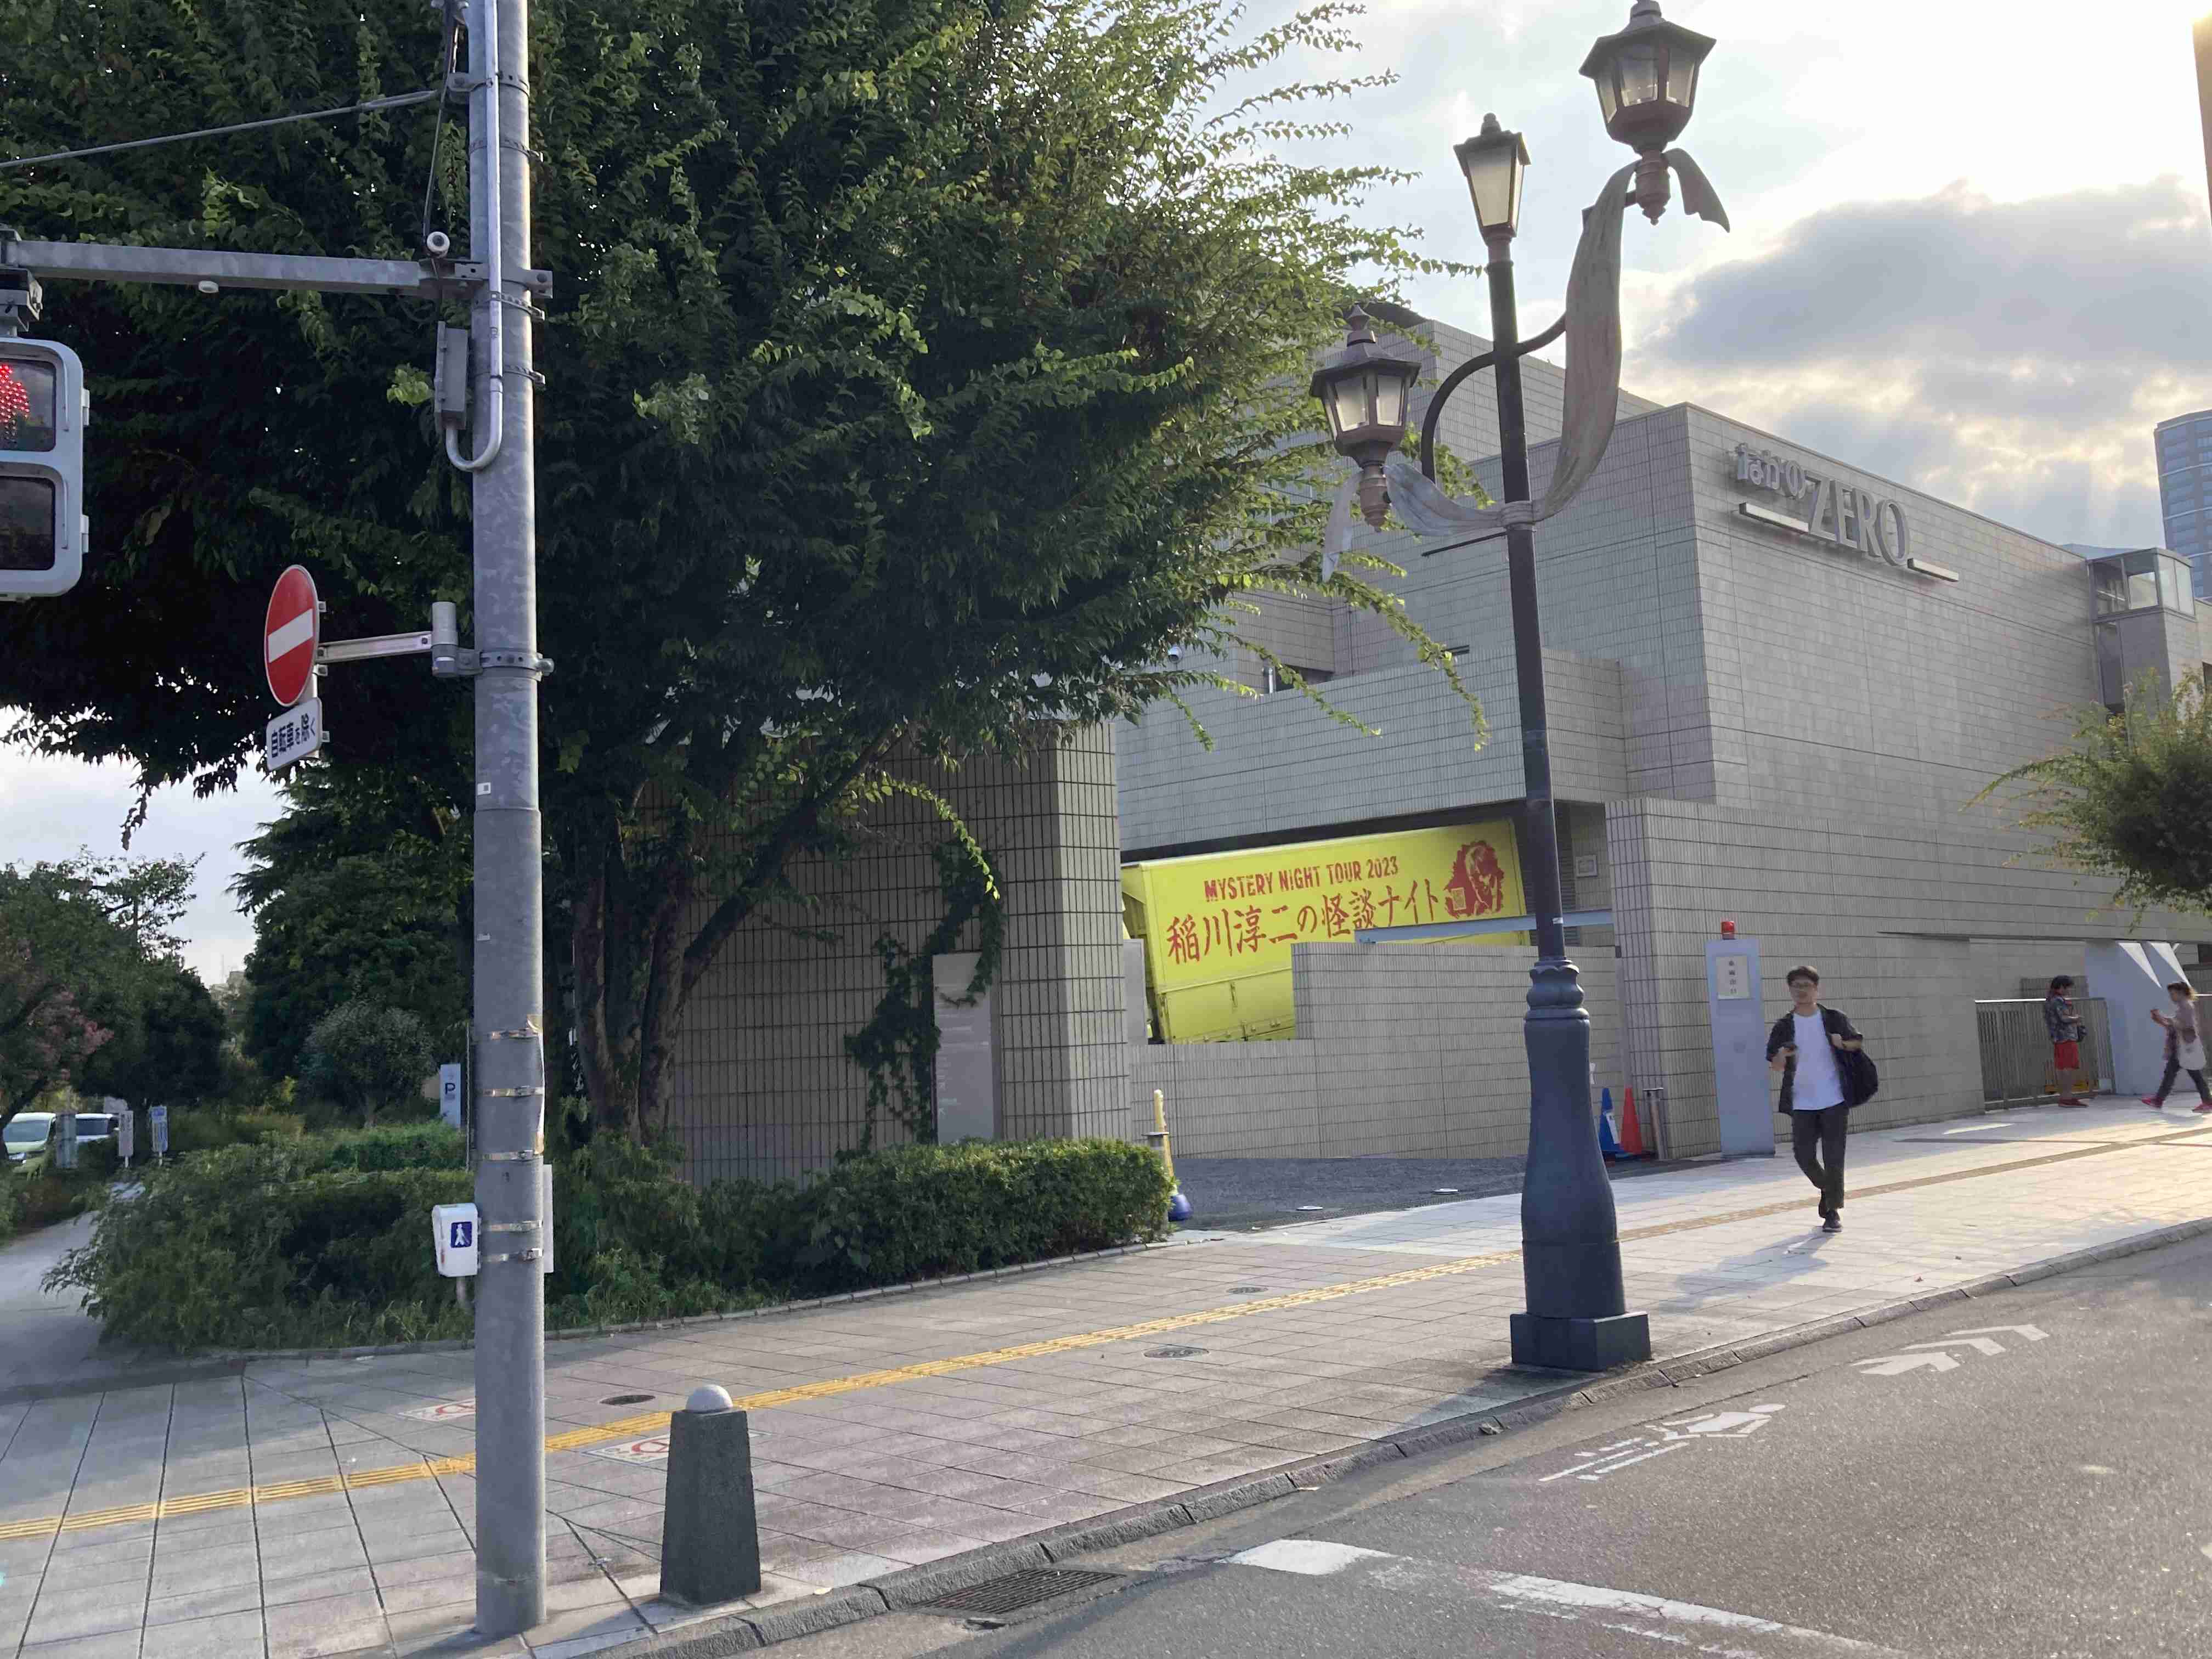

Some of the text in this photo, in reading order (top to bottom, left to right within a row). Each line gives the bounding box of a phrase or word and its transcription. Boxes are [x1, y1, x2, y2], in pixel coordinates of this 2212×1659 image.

[1204, 856, 1398, 902] MYSTERY NIGHT TOUR 2023
[1167, 878, 1438, 964] 稲川淳二の怪談ナイト
[445, 1082, 455, 1094] P
